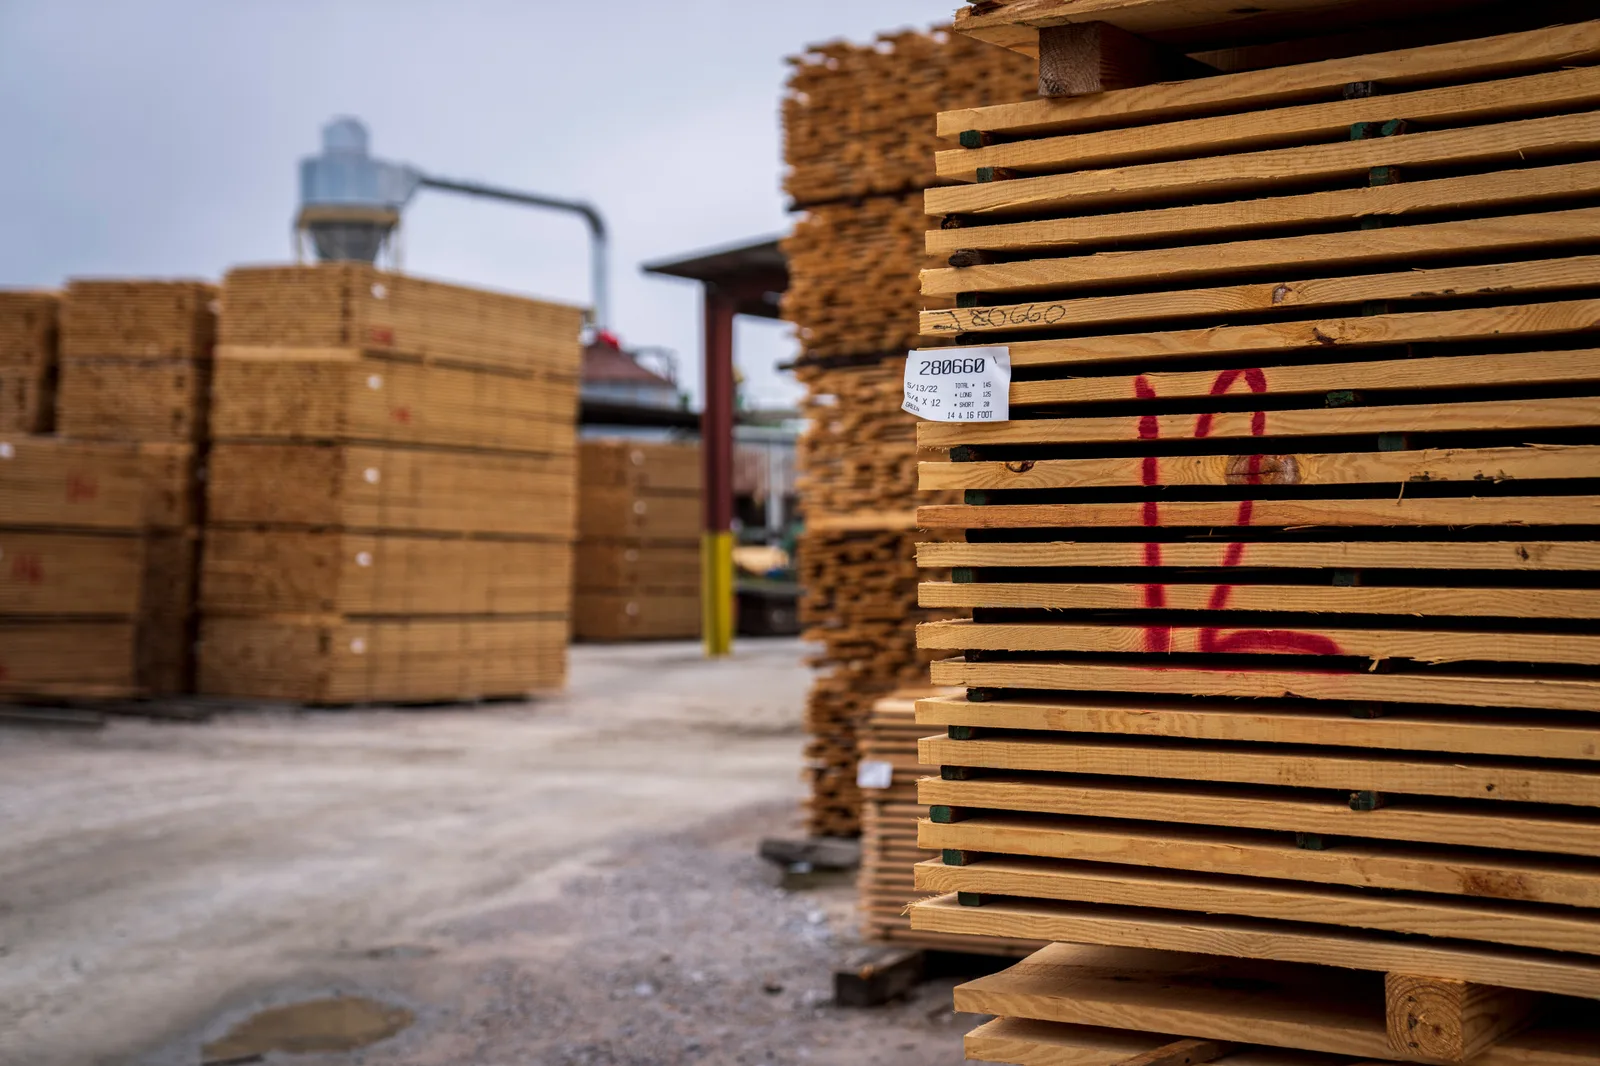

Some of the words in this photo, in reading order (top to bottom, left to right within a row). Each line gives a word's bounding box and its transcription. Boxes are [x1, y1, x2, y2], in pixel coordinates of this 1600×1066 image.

[919, 357, 985, 376] 280660
[906, 381, 938, 393] 5/13/22
[906, 391, 918, 403] 5/4
[922, 397, 928, 406] X
[947, 411, 955, 419] 14
[966, 410, 974, 419] 16
[977, 410, 993, 419] FOOT
